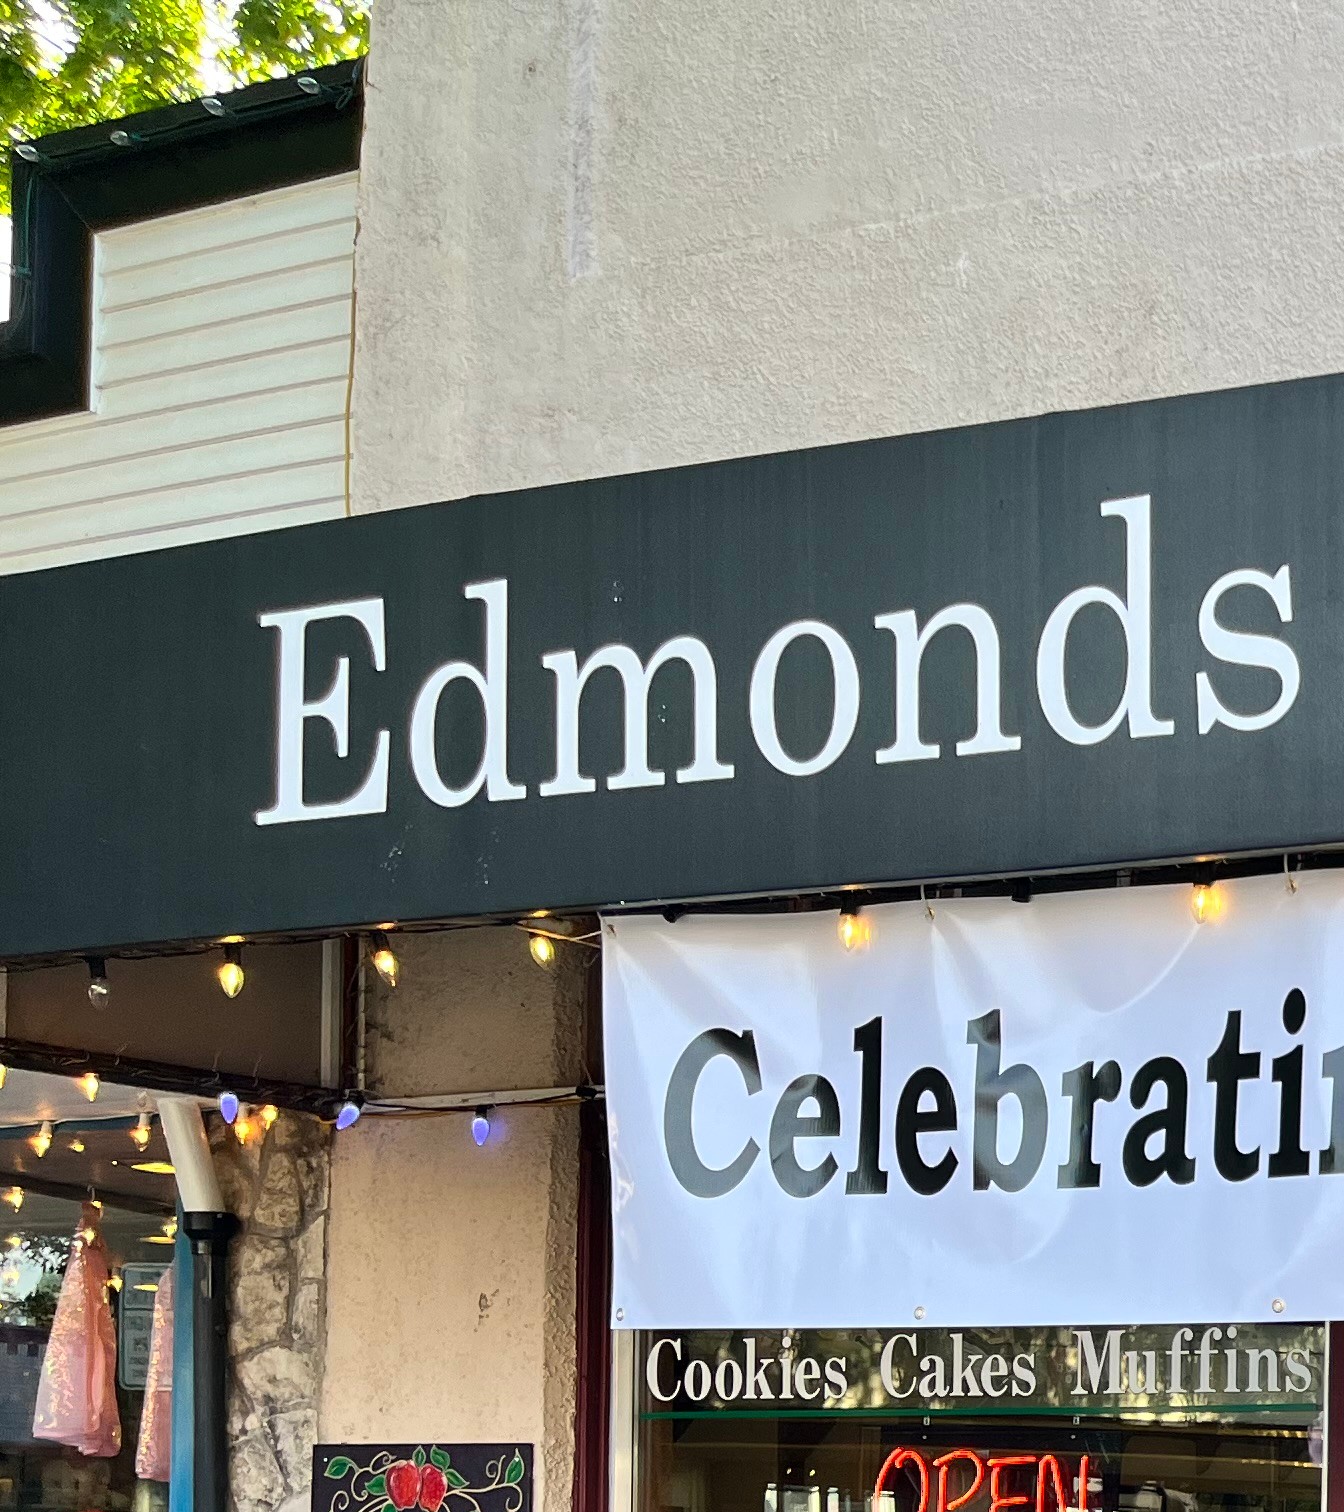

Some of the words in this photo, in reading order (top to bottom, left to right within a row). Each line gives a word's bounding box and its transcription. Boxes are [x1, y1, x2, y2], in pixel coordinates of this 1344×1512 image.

[254, 494, 1302, 826] Edmonds
[645, 1336, 848, 1402] Cookies
[879, 1332, 1037, 1399] Cakes
[1070, 1326, 1313, 1397] Muffins
